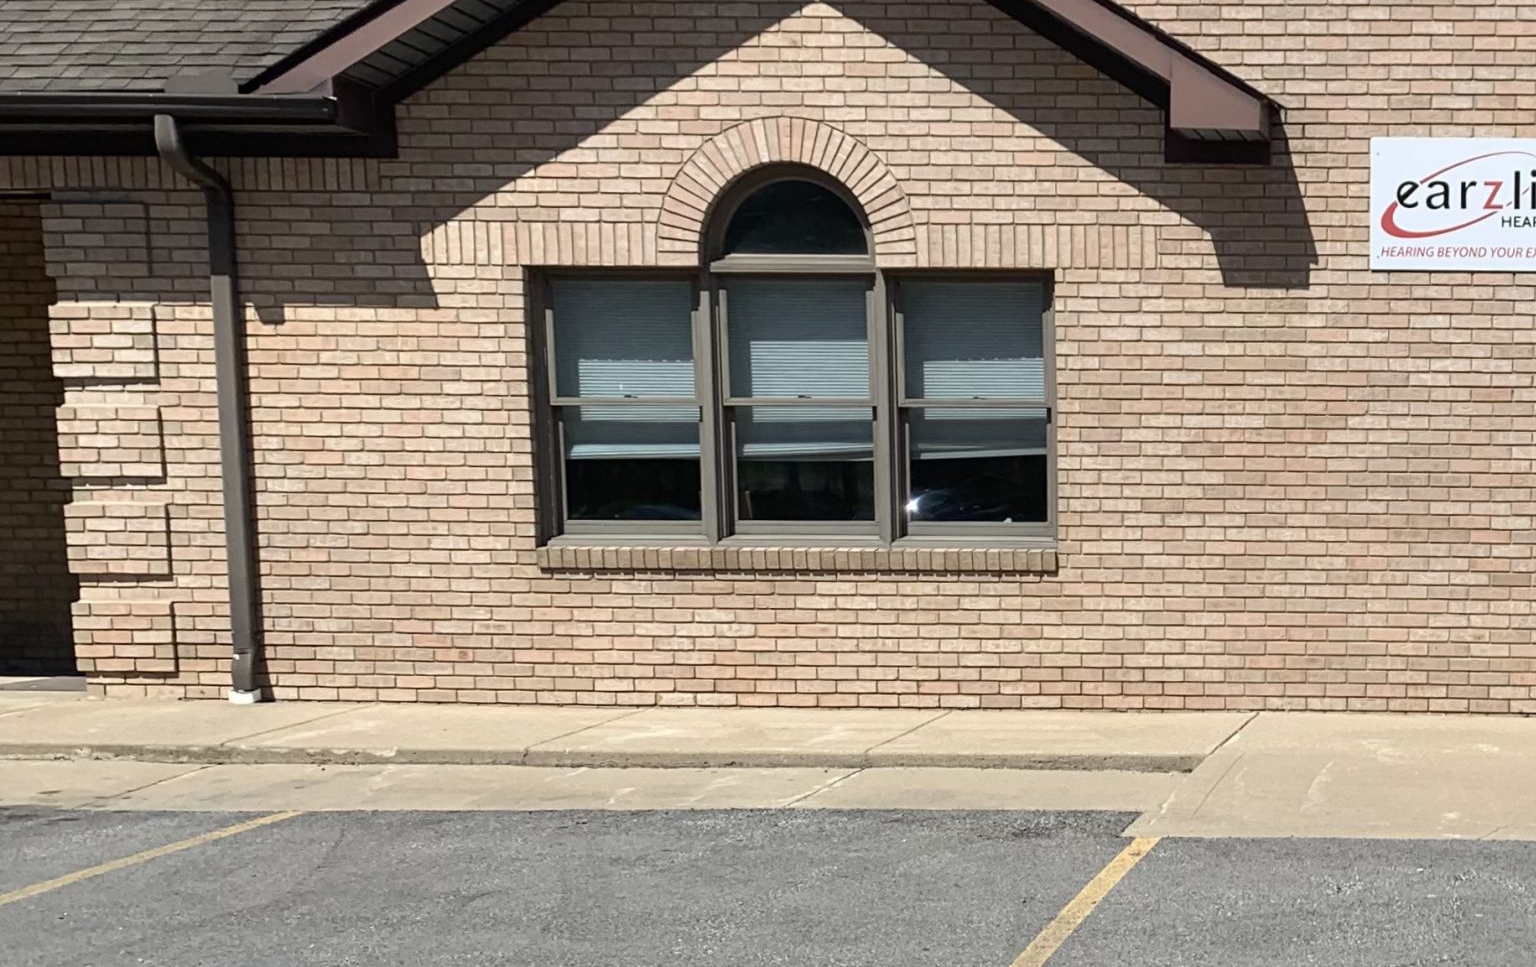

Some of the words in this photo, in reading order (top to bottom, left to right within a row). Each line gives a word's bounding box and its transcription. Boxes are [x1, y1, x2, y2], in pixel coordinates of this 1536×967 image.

[1381, 246, 1435, 258] HEARING
[1437, 246, 1488, 258] BEYOND
[1490, 247, 1523, 258] YOUR
